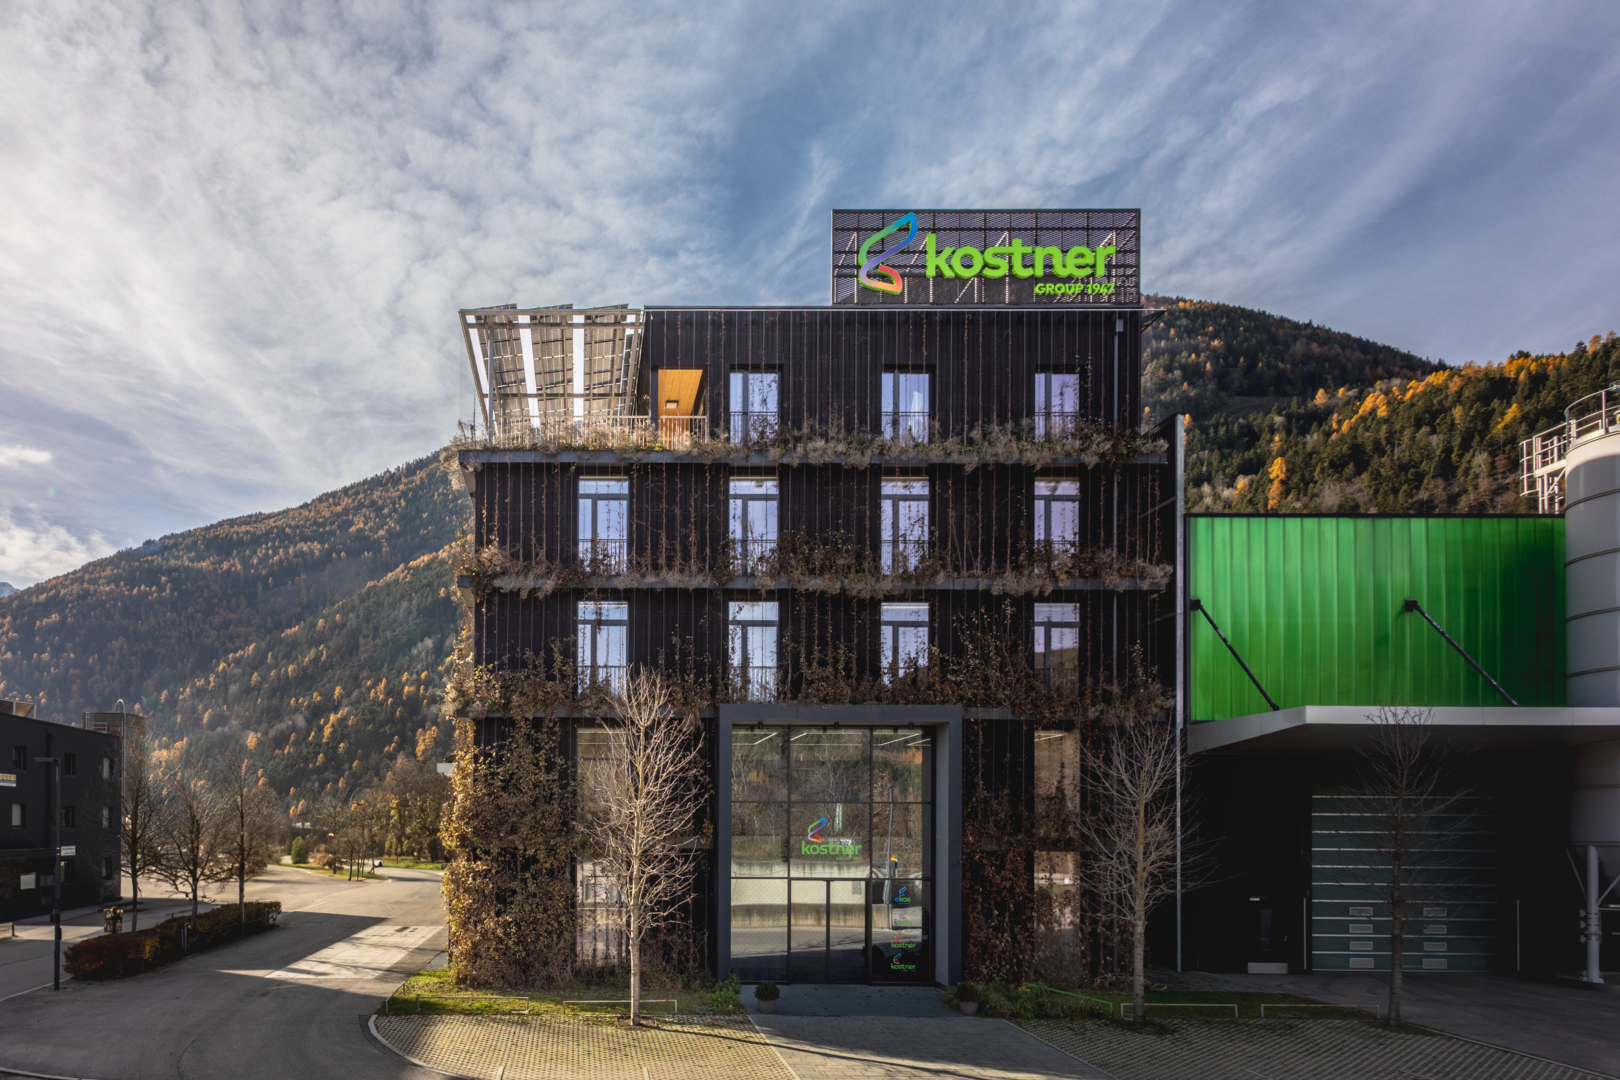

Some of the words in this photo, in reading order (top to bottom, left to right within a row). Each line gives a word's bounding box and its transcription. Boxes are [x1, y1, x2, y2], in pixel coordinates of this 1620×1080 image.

[926, 233, 1117, 278] kostner
[1034, 283, 1084, 295] GROUP
[1086, 283, 1115, 295] 1947
[801, 840, 862, 855] kostner
